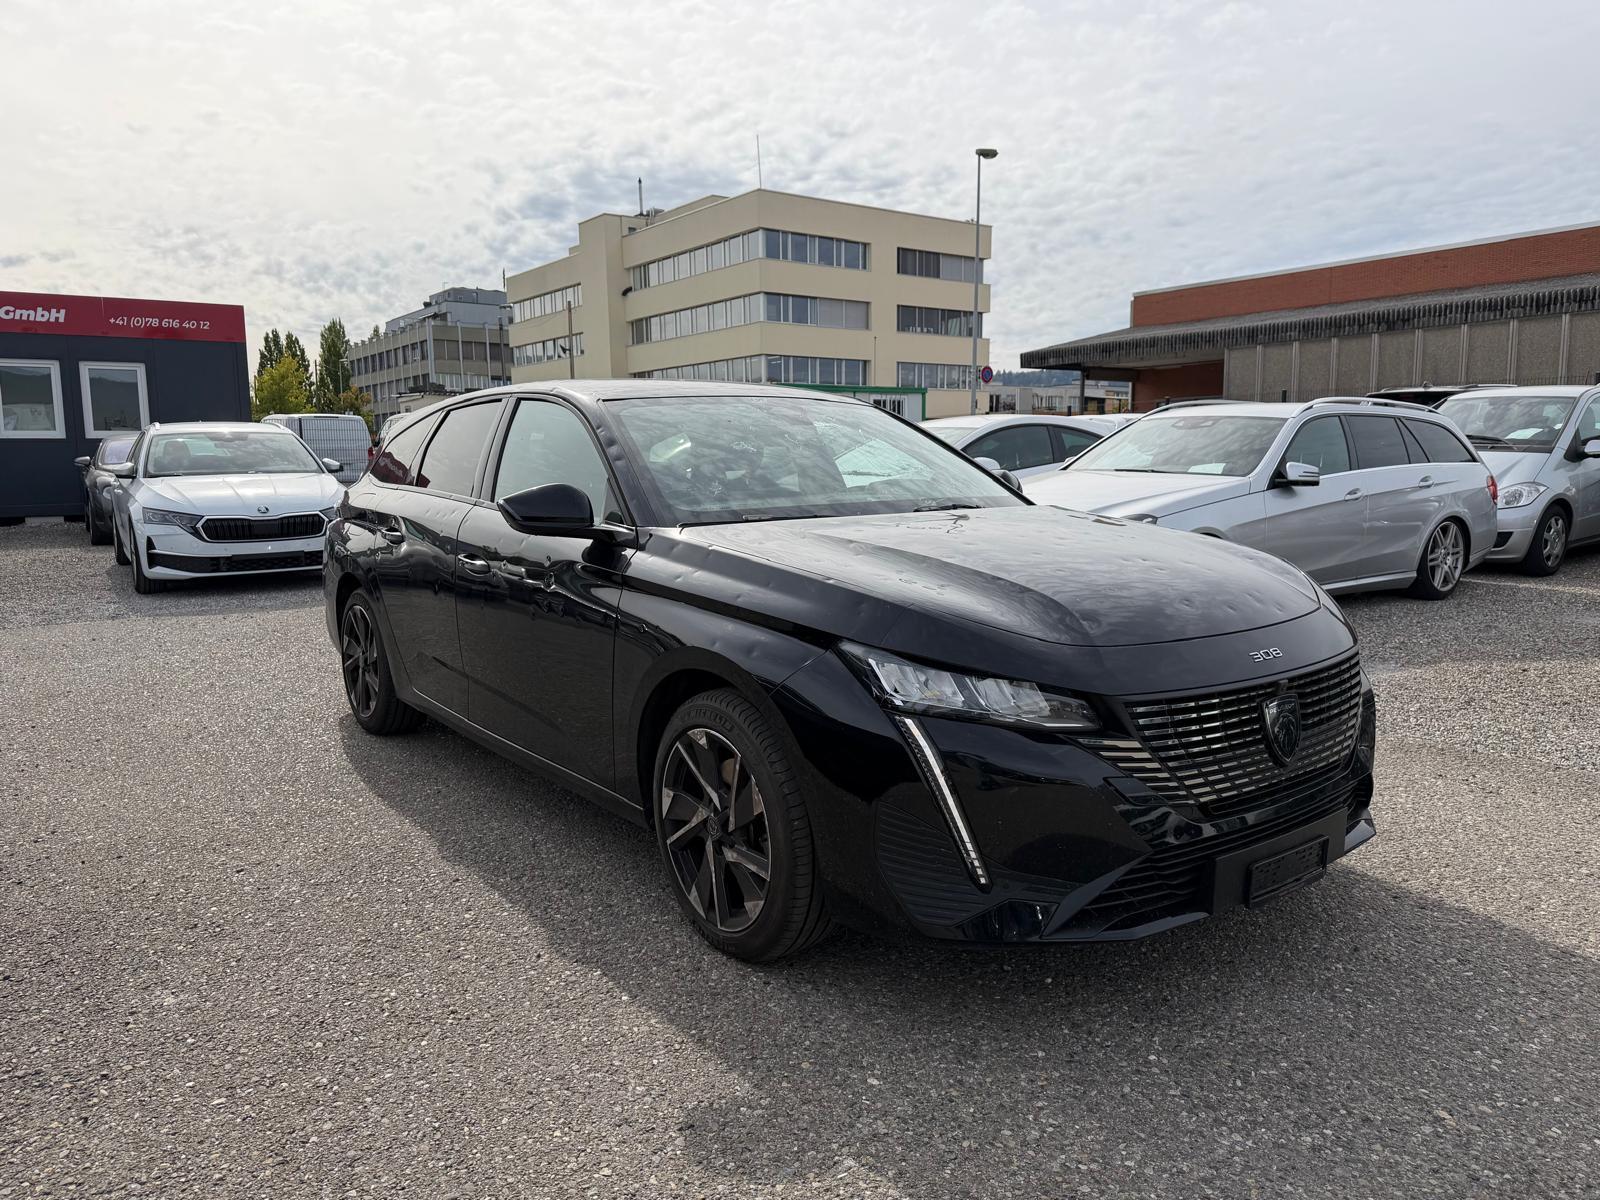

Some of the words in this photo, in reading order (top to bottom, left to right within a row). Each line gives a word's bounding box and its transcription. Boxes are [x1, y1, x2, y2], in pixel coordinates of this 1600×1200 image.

[0, 306, 66, 322] GmbH
[109, 316, 127, 326] +41
[130, 317, 159, 328] (0)78
[161, 319, 180, 329] 616
[182, 320, 197, 329] 40
[199, 321, 210, 330] 12
[1249, 647, 1283, 662] 308
